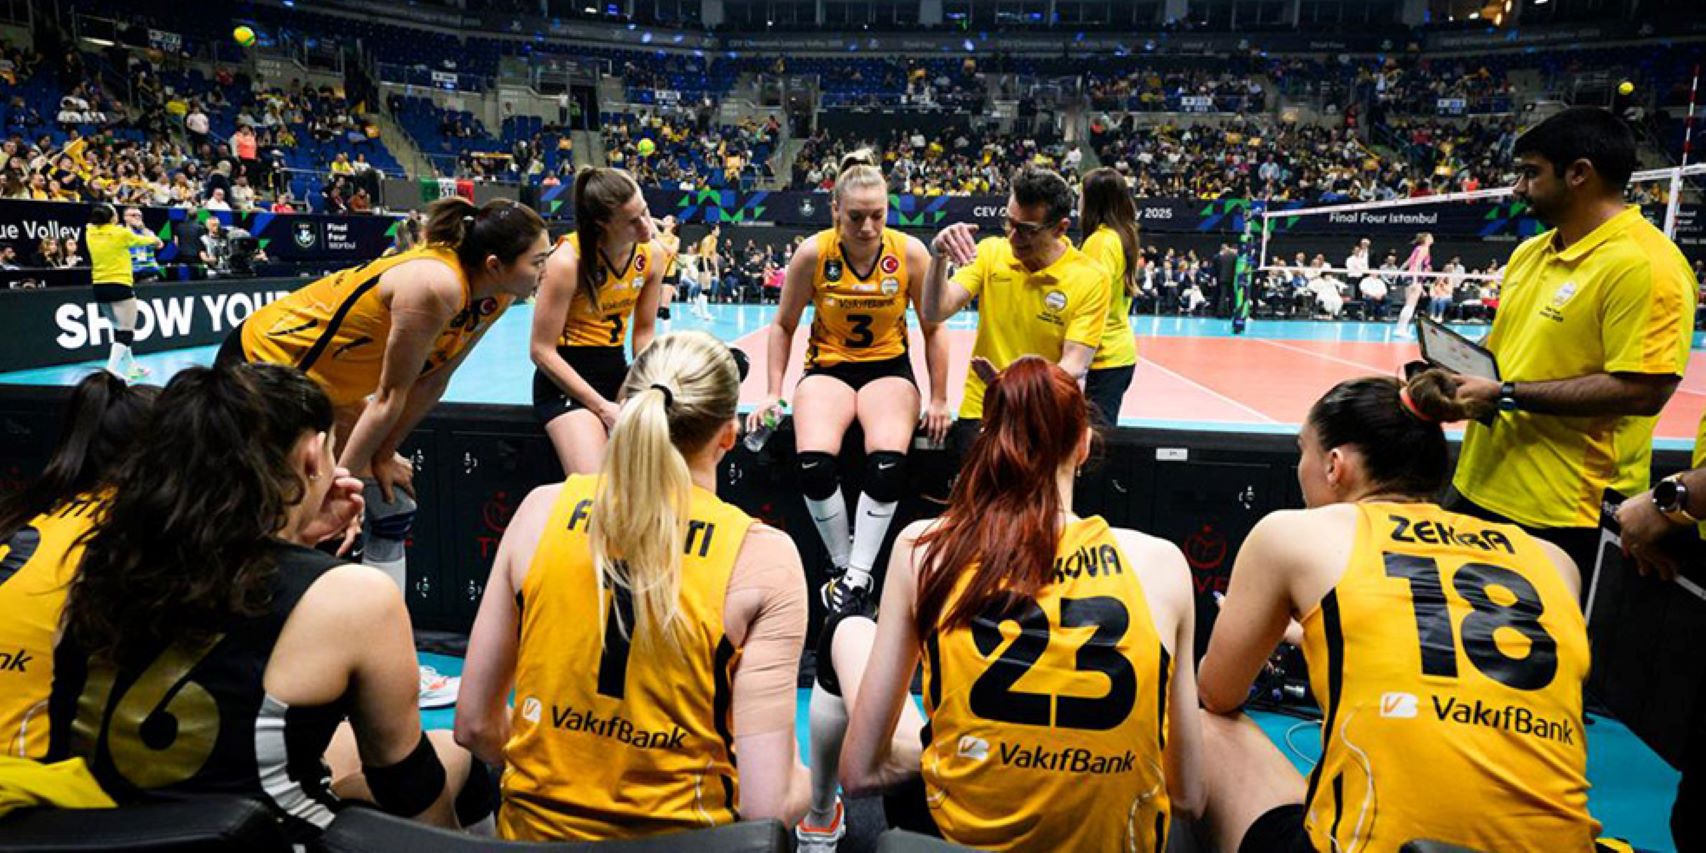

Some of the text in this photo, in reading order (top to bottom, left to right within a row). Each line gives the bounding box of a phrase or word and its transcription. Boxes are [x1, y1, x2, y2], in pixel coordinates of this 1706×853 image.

[973, 205, 996, 217] CEV
[1144, 207, 1172, 218] 2025
[1329, 211, 1358, 223] Final
[1360, 211, 1387, 224] Four
[22, 220, 81, 242] Volley
[327, 222, 348, 232] Final
[328, 232, 347, 241] Four
[55, 290, 291, 349] SHOW YOU
[844, 314, 874, 347] 3
[1388, 514, 1516, 554] ZEHRA
[1052, 543, 1123, 584] KOVA
[1382, 550, 1558, 691] 18
[969, 588, 1138, 732] 23
